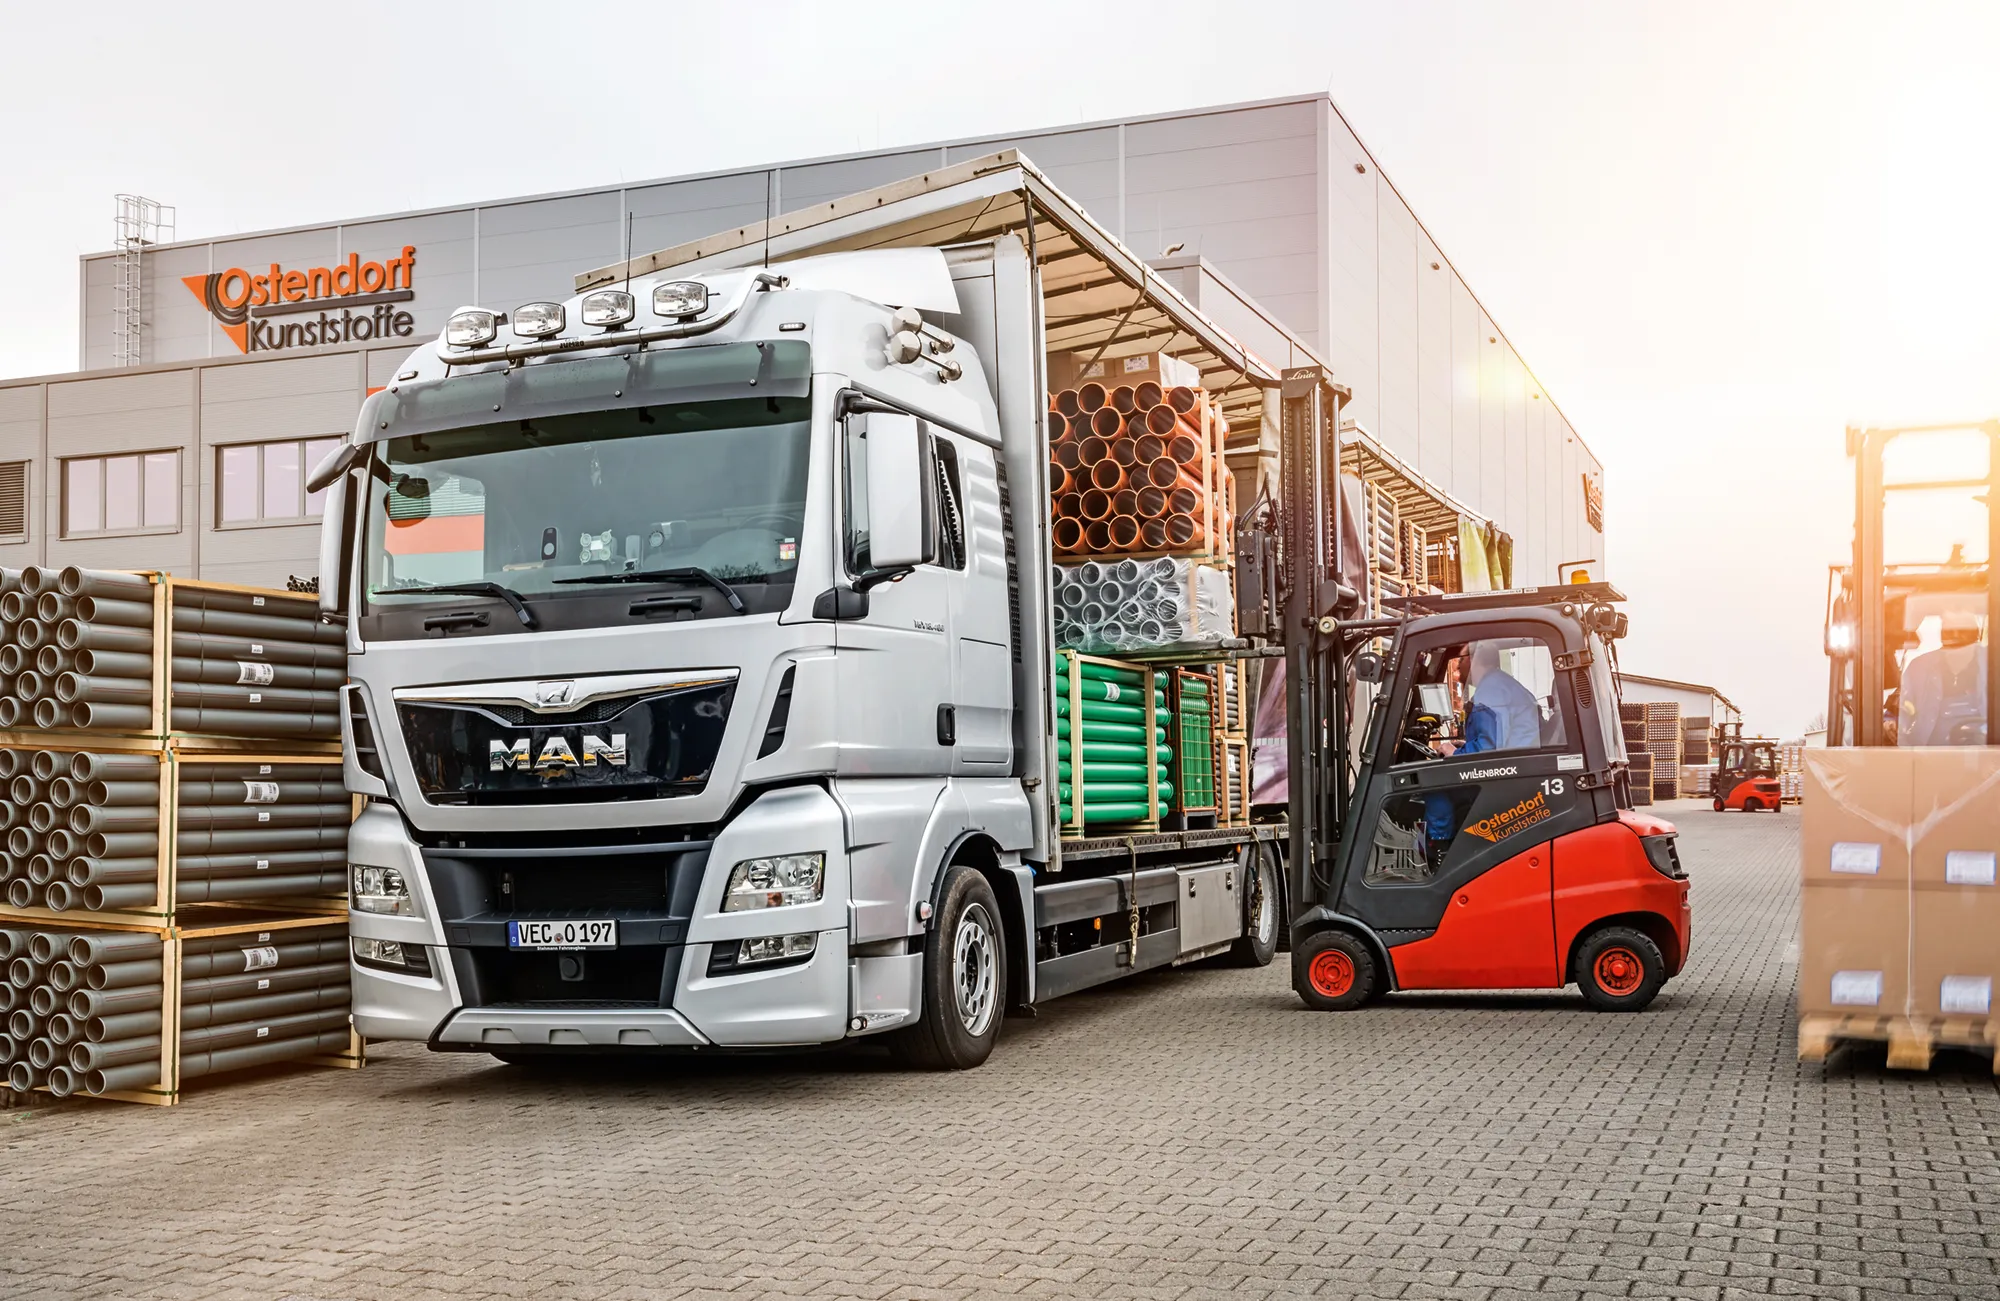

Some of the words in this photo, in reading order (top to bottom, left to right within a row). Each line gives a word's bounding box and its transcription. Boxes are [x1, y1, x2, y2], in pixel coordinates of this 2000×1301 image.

[217, 245, 415, 309] Ostendorf
[250, 304, 414, 351] Kunststoffe
[1286, 369, 1316, 381] Linde
[489, 733, 627, 771] MAN
[1459, 766, 1518, 781] WILLENBROCK
[1540, 778, 1565, 796] 13
[1479, 791, 1545, 832] Ostendorf
[1494, 808, 1551, 841] Kunststoffe
[519, 924, 553, 944] VEC
[579, 922, 612, 943] 197
